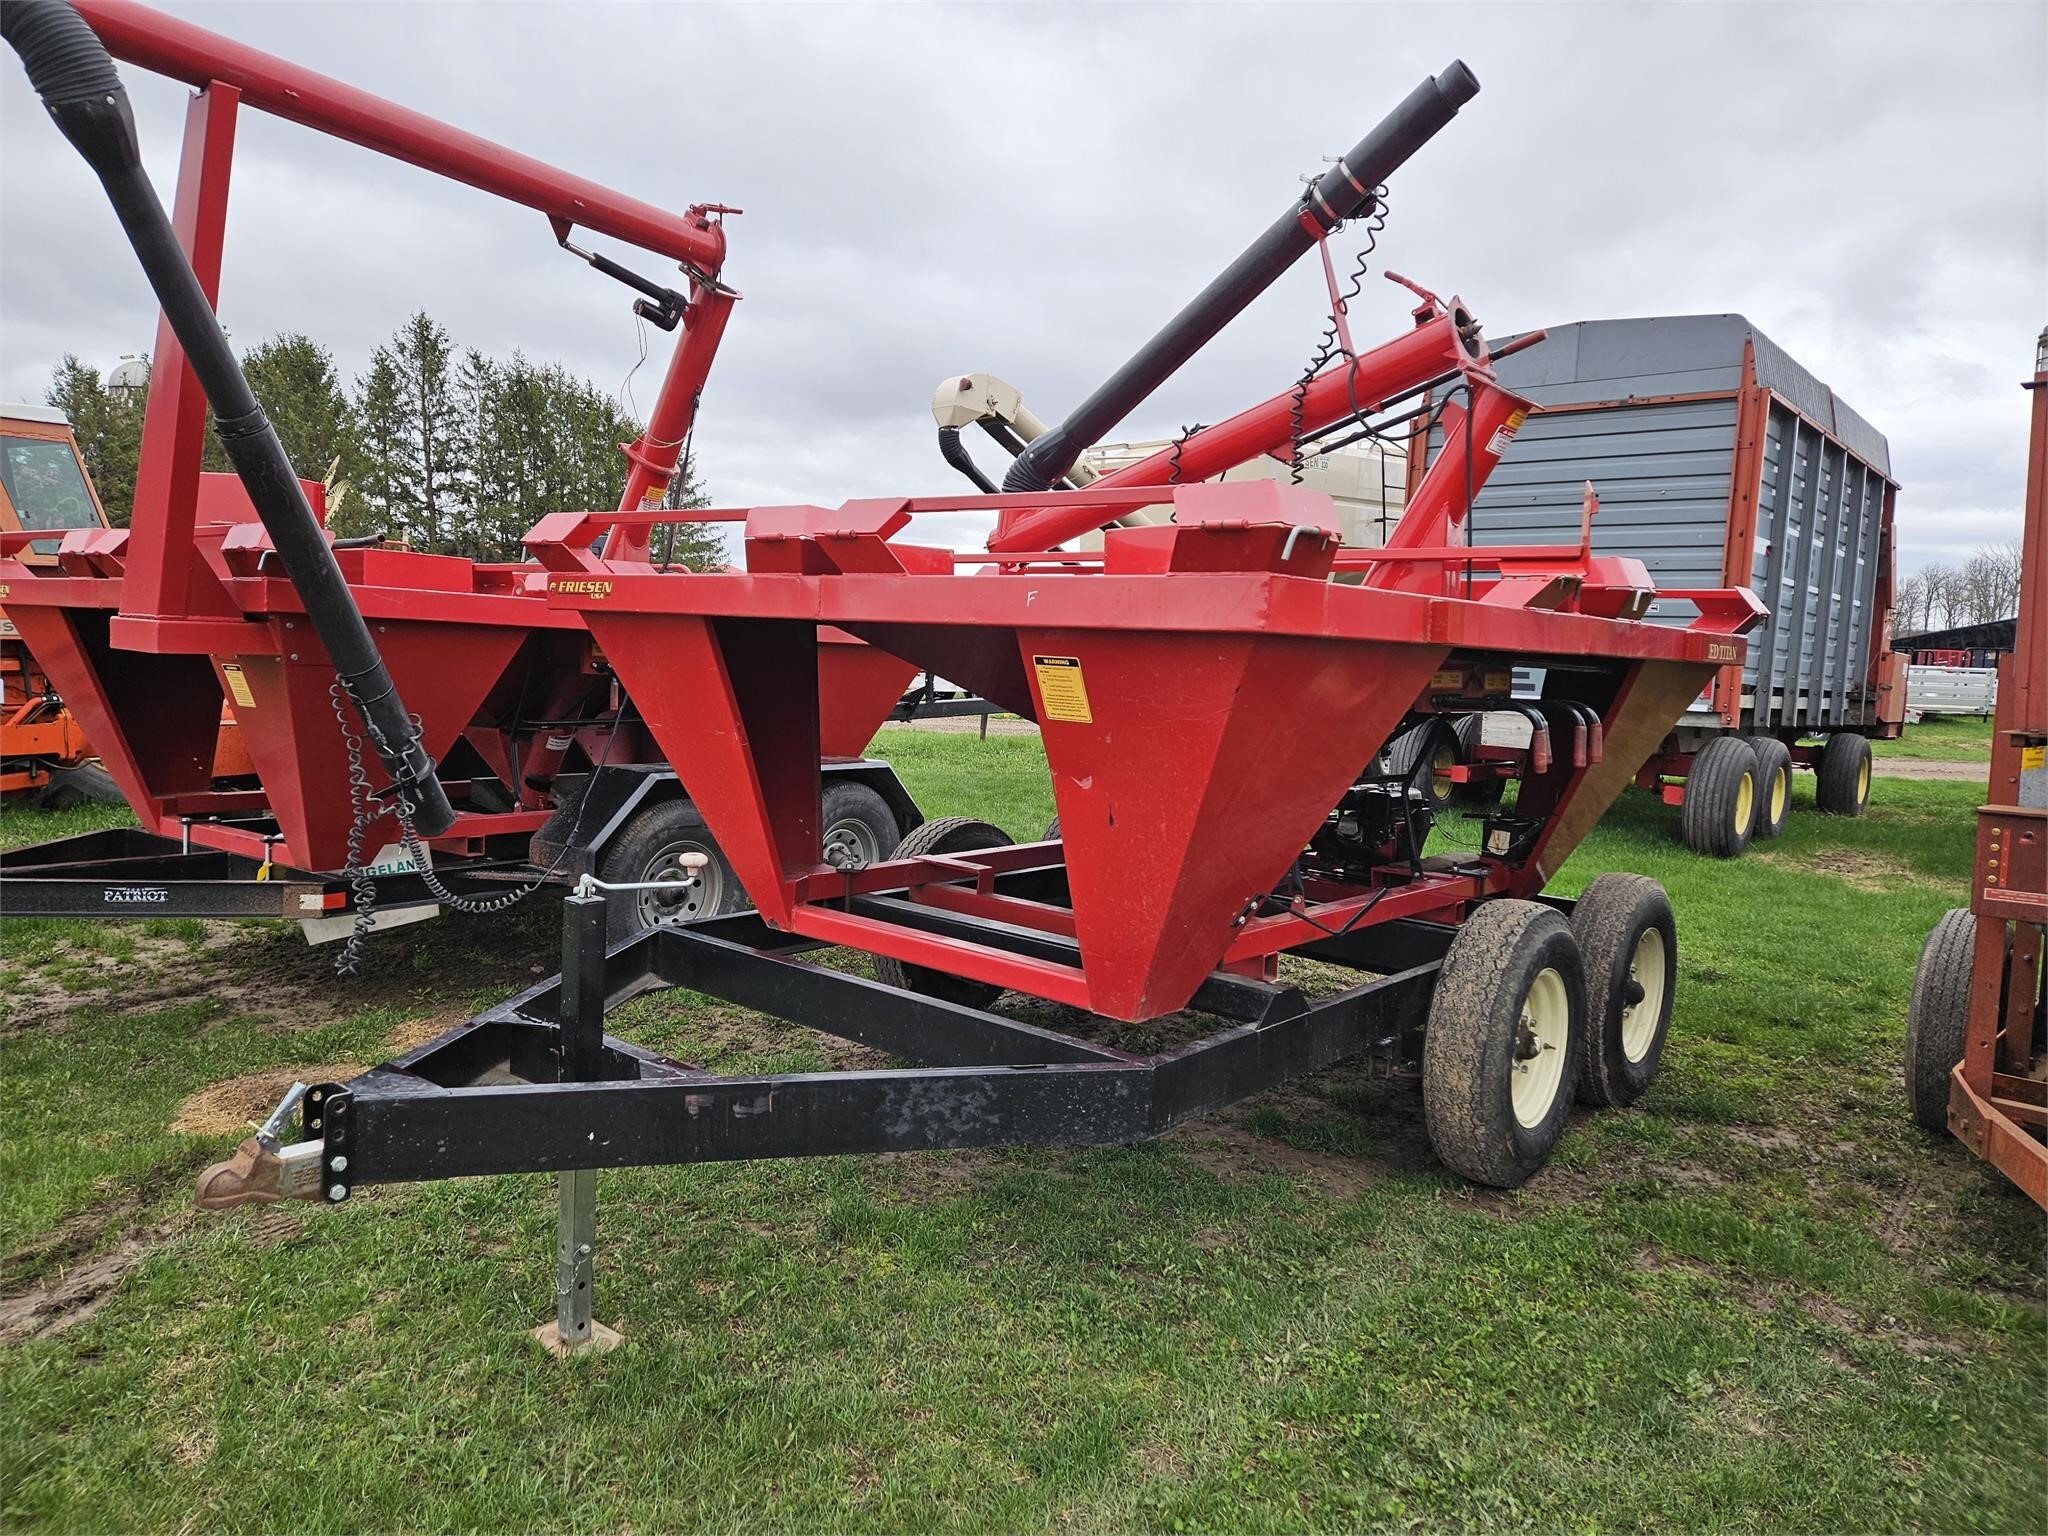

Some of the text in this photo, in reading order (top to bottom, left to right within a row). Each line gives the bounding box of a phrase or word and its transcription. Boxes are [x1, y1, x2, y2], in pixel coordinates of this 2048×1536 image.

[558, 581, 613, 593] FRIESEN
[590, 592, 604, 600] USA
[1042, 658, 1070, 666] WARNING
[104, 890, 169, 902] PATRIOT
